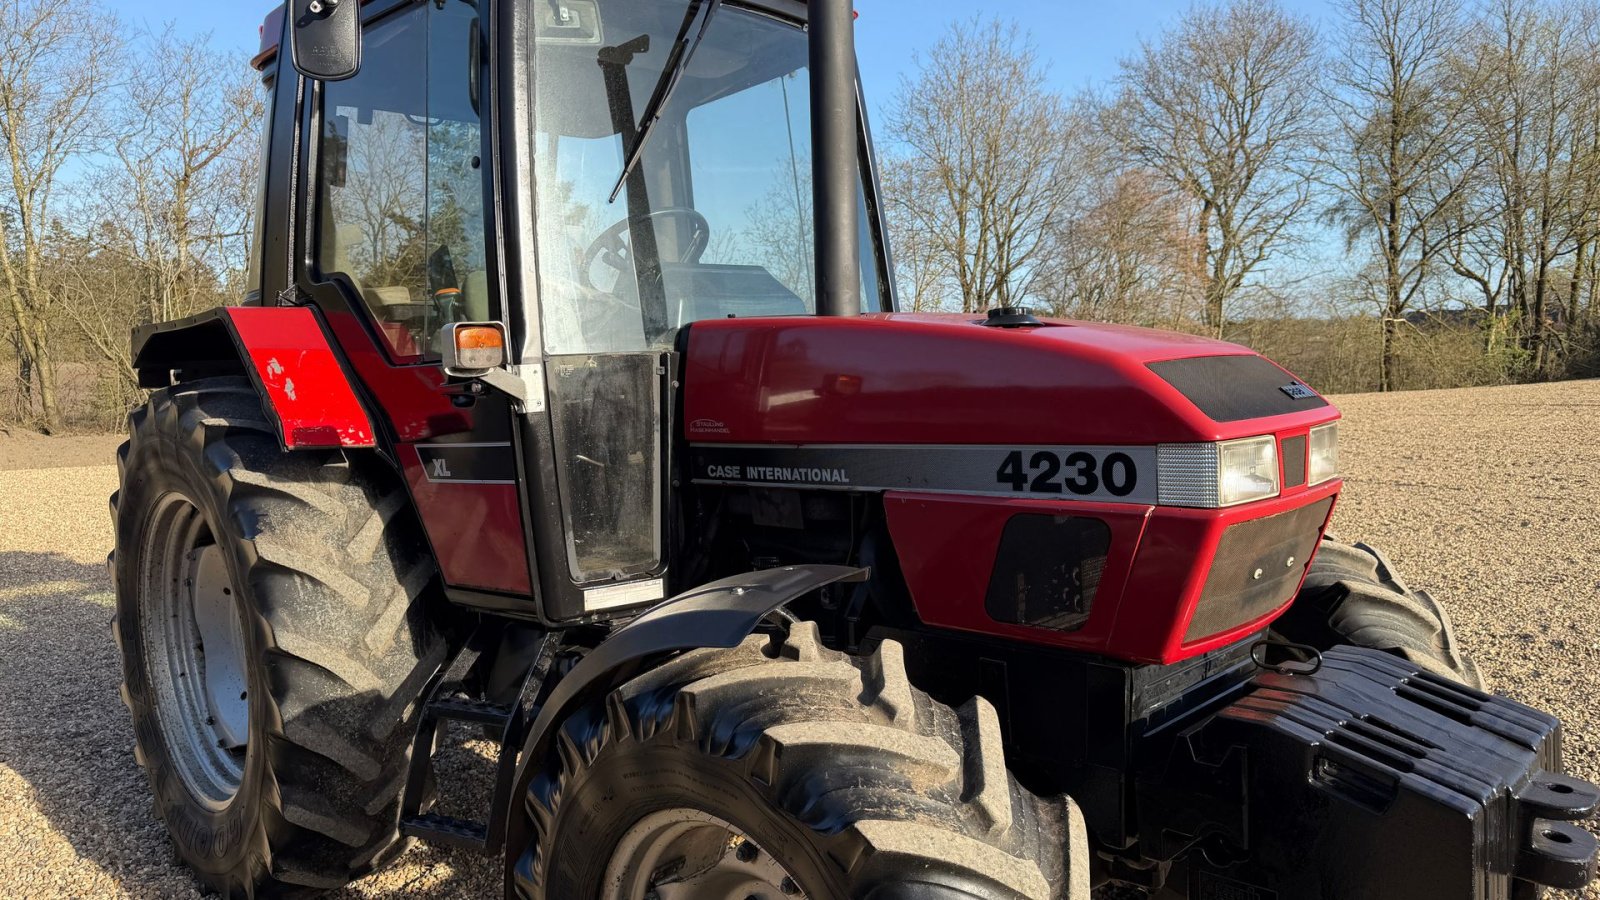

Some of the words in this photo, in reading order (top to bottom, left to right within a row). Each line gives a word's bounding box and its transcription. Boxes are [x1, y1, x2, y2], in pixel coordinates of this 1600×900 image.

[432, 458, 451, 477] XL
[707, 464, 741, 478] CASE
[746, 466, 850, 483] INTERNATIONAL
[996, 450, 1138, 497] 4230
